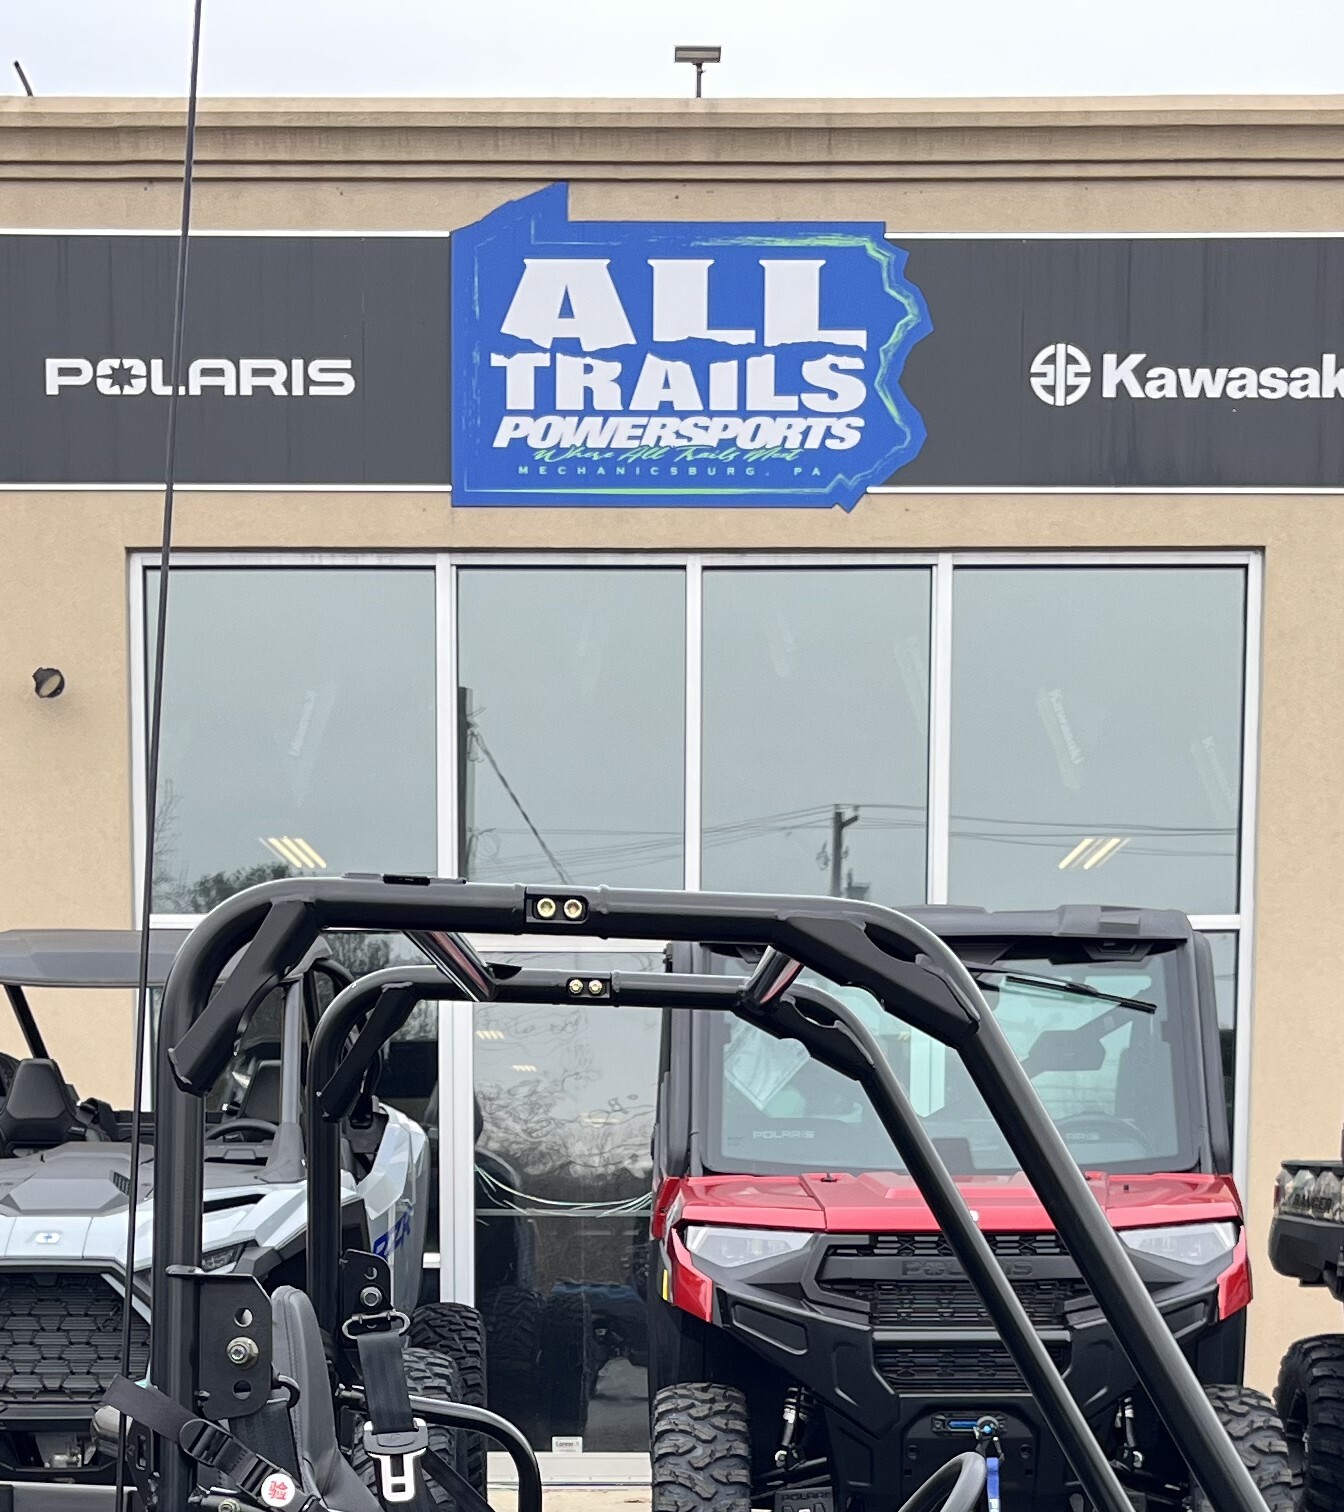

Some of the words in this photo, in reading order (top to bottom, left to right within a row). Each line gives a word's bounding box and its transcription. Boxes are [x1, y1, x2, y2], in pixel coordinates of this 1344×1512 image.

[500, 258, 867, 352] ALL
[45, 358, 355, 396] POLARIS
[490, 353, 867, 412] TRAILS
[492, 415, 865, 450] POWERSPORTS
[617, 445, 670, 463] All
[674, 446, 741, 463] Trails
[793, 467, 821, 476] PA
[752, 1130, 815, 1139] POLARIS
